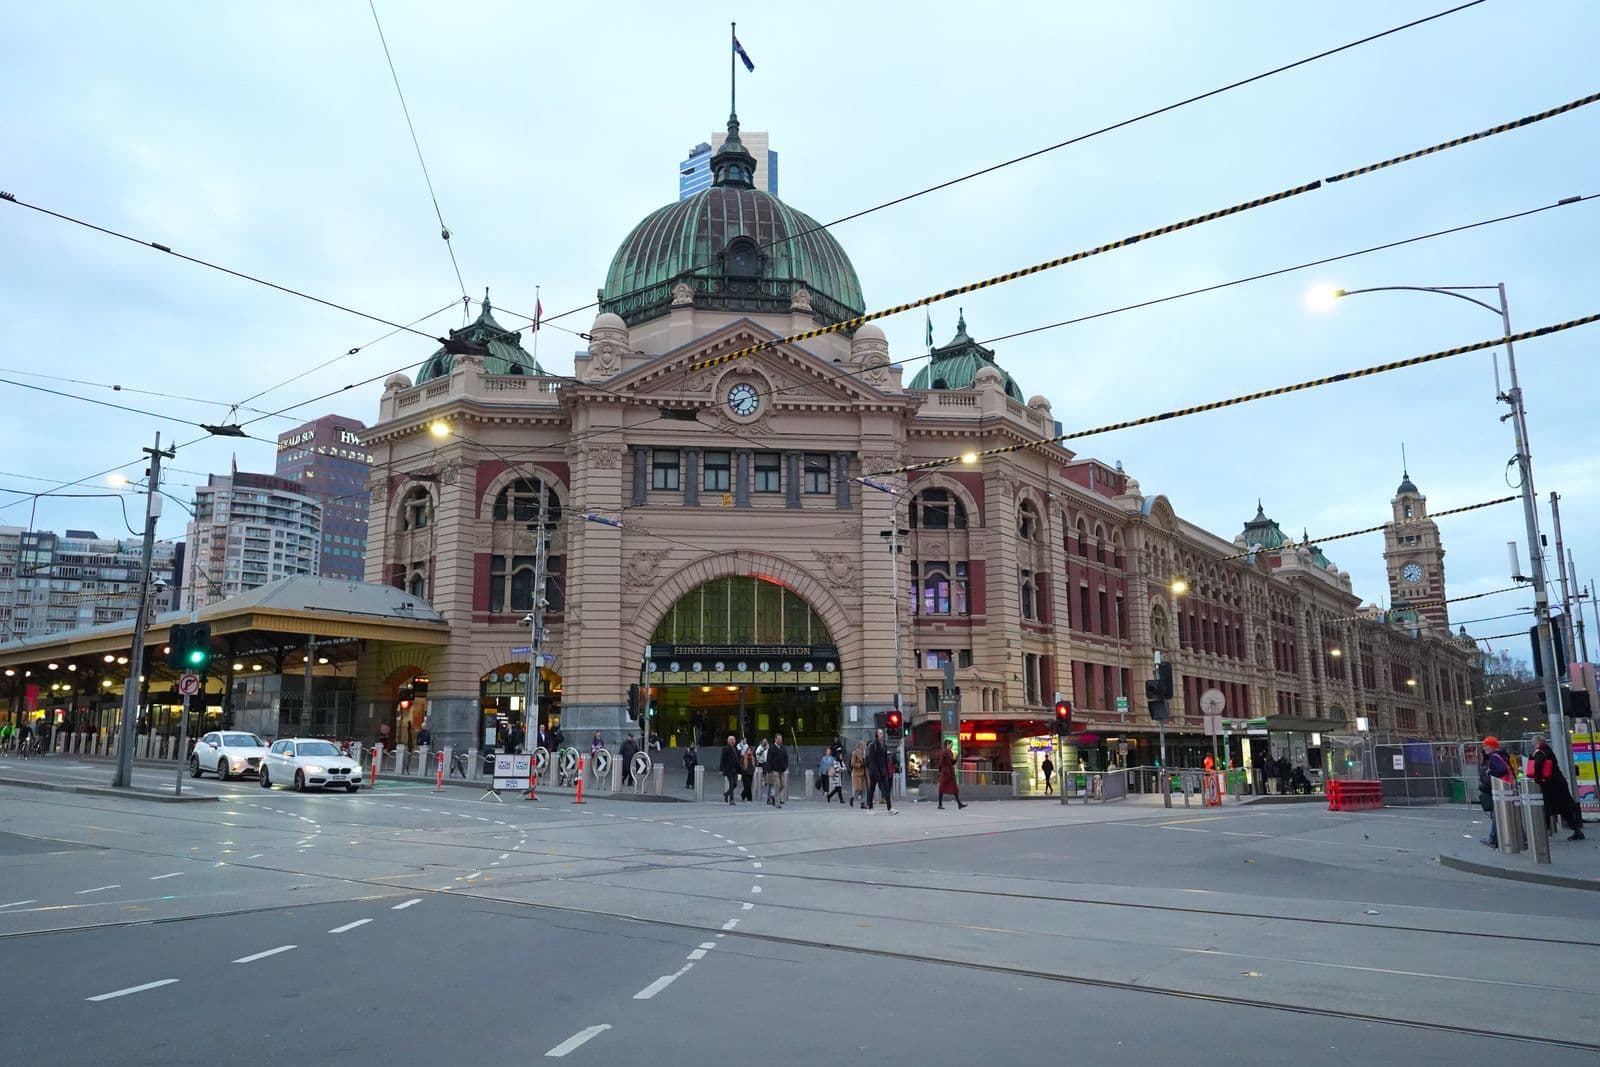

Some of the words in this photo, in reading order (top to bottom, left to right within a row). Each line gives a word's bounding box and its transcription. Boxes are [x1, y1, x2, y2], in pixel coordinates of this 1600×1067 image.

[301, 430, 315, 442] SUN
[341, 430, 366, 446] HW
[674, 646, 718, 655] FLINDERS
[728, 646, 760, 655] STREET
[771, 646, 811, 655] STATION
